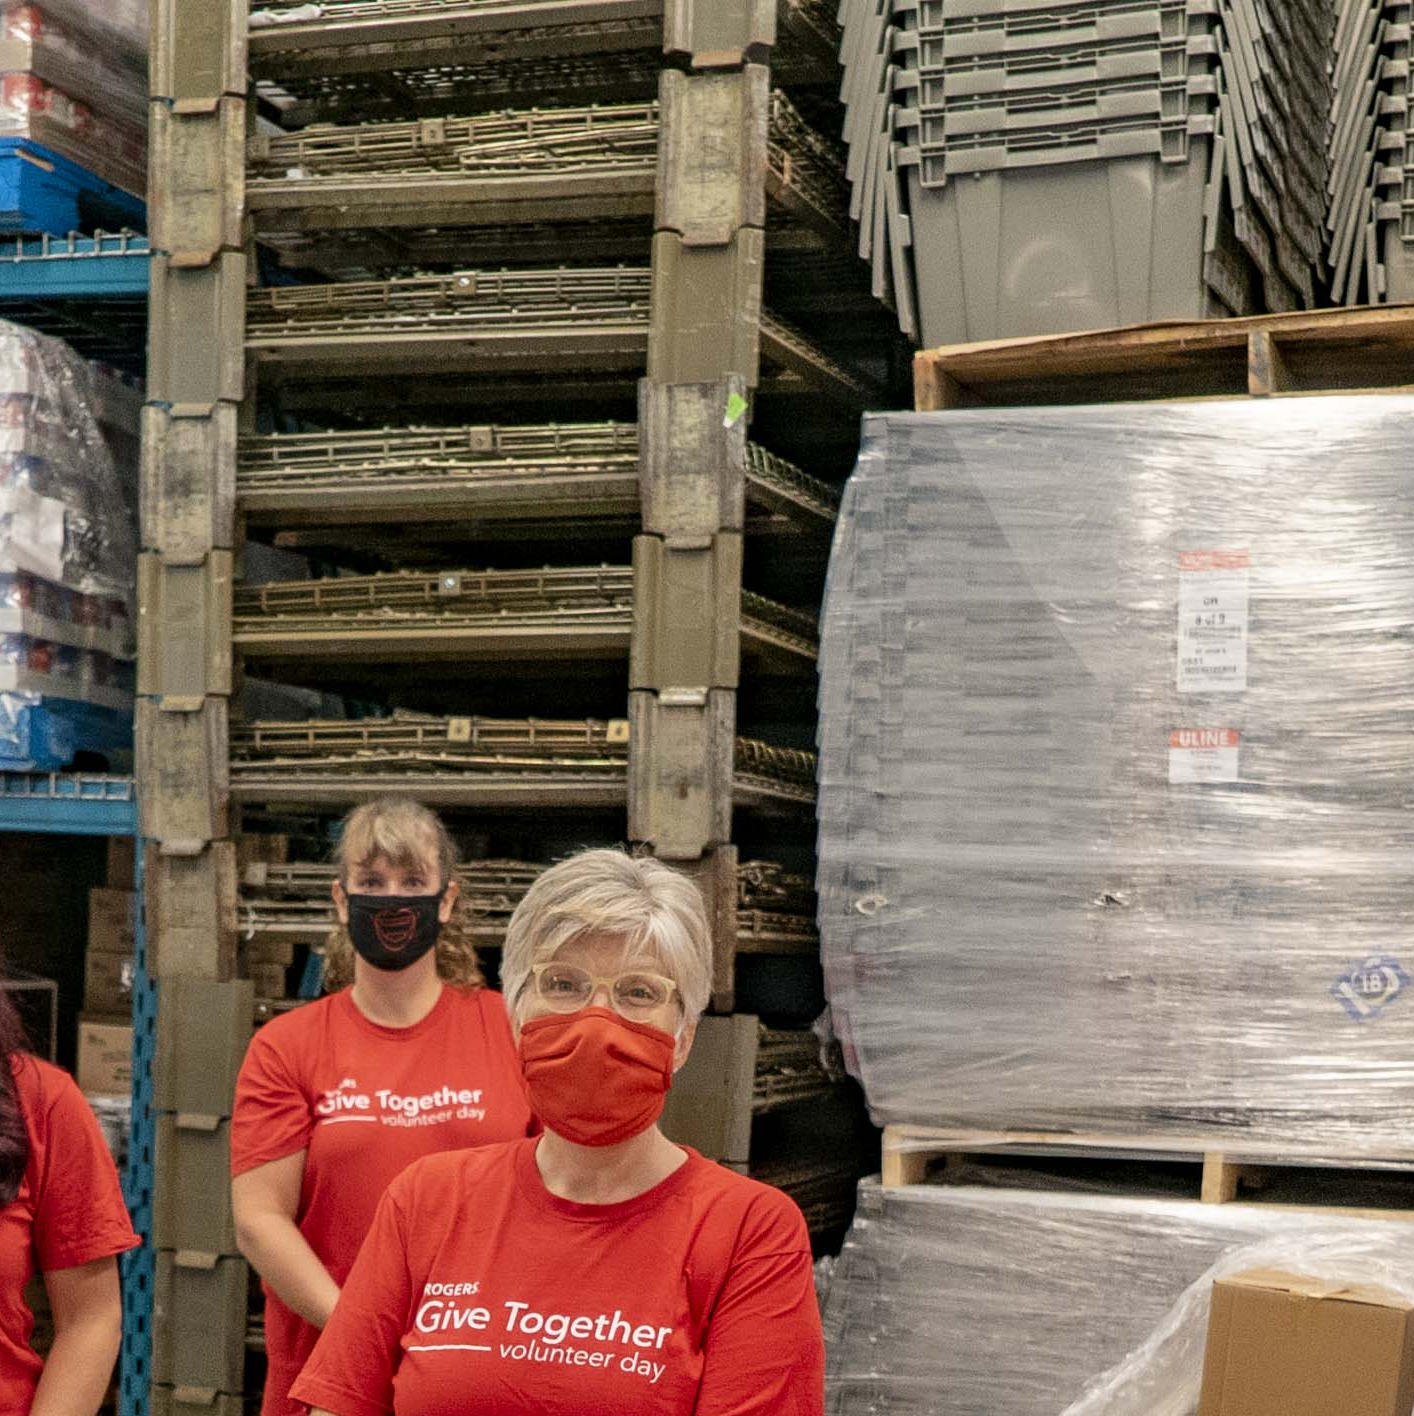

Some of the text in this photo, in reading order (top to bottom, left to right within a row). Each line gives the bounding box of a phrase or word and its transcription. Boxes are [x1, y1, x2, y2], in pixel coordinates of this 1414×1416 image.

[1179, 730, 1228, 747] ULINE
[375, 1086, 483, 1117] Together
[381, 1106, 486, 1127] volunteer day
[424, 1281, 480, 1297] ROGERS
[415, 1300, 673, 1350] Give Together
[499, 1339, 667, 1384] volunteer day
